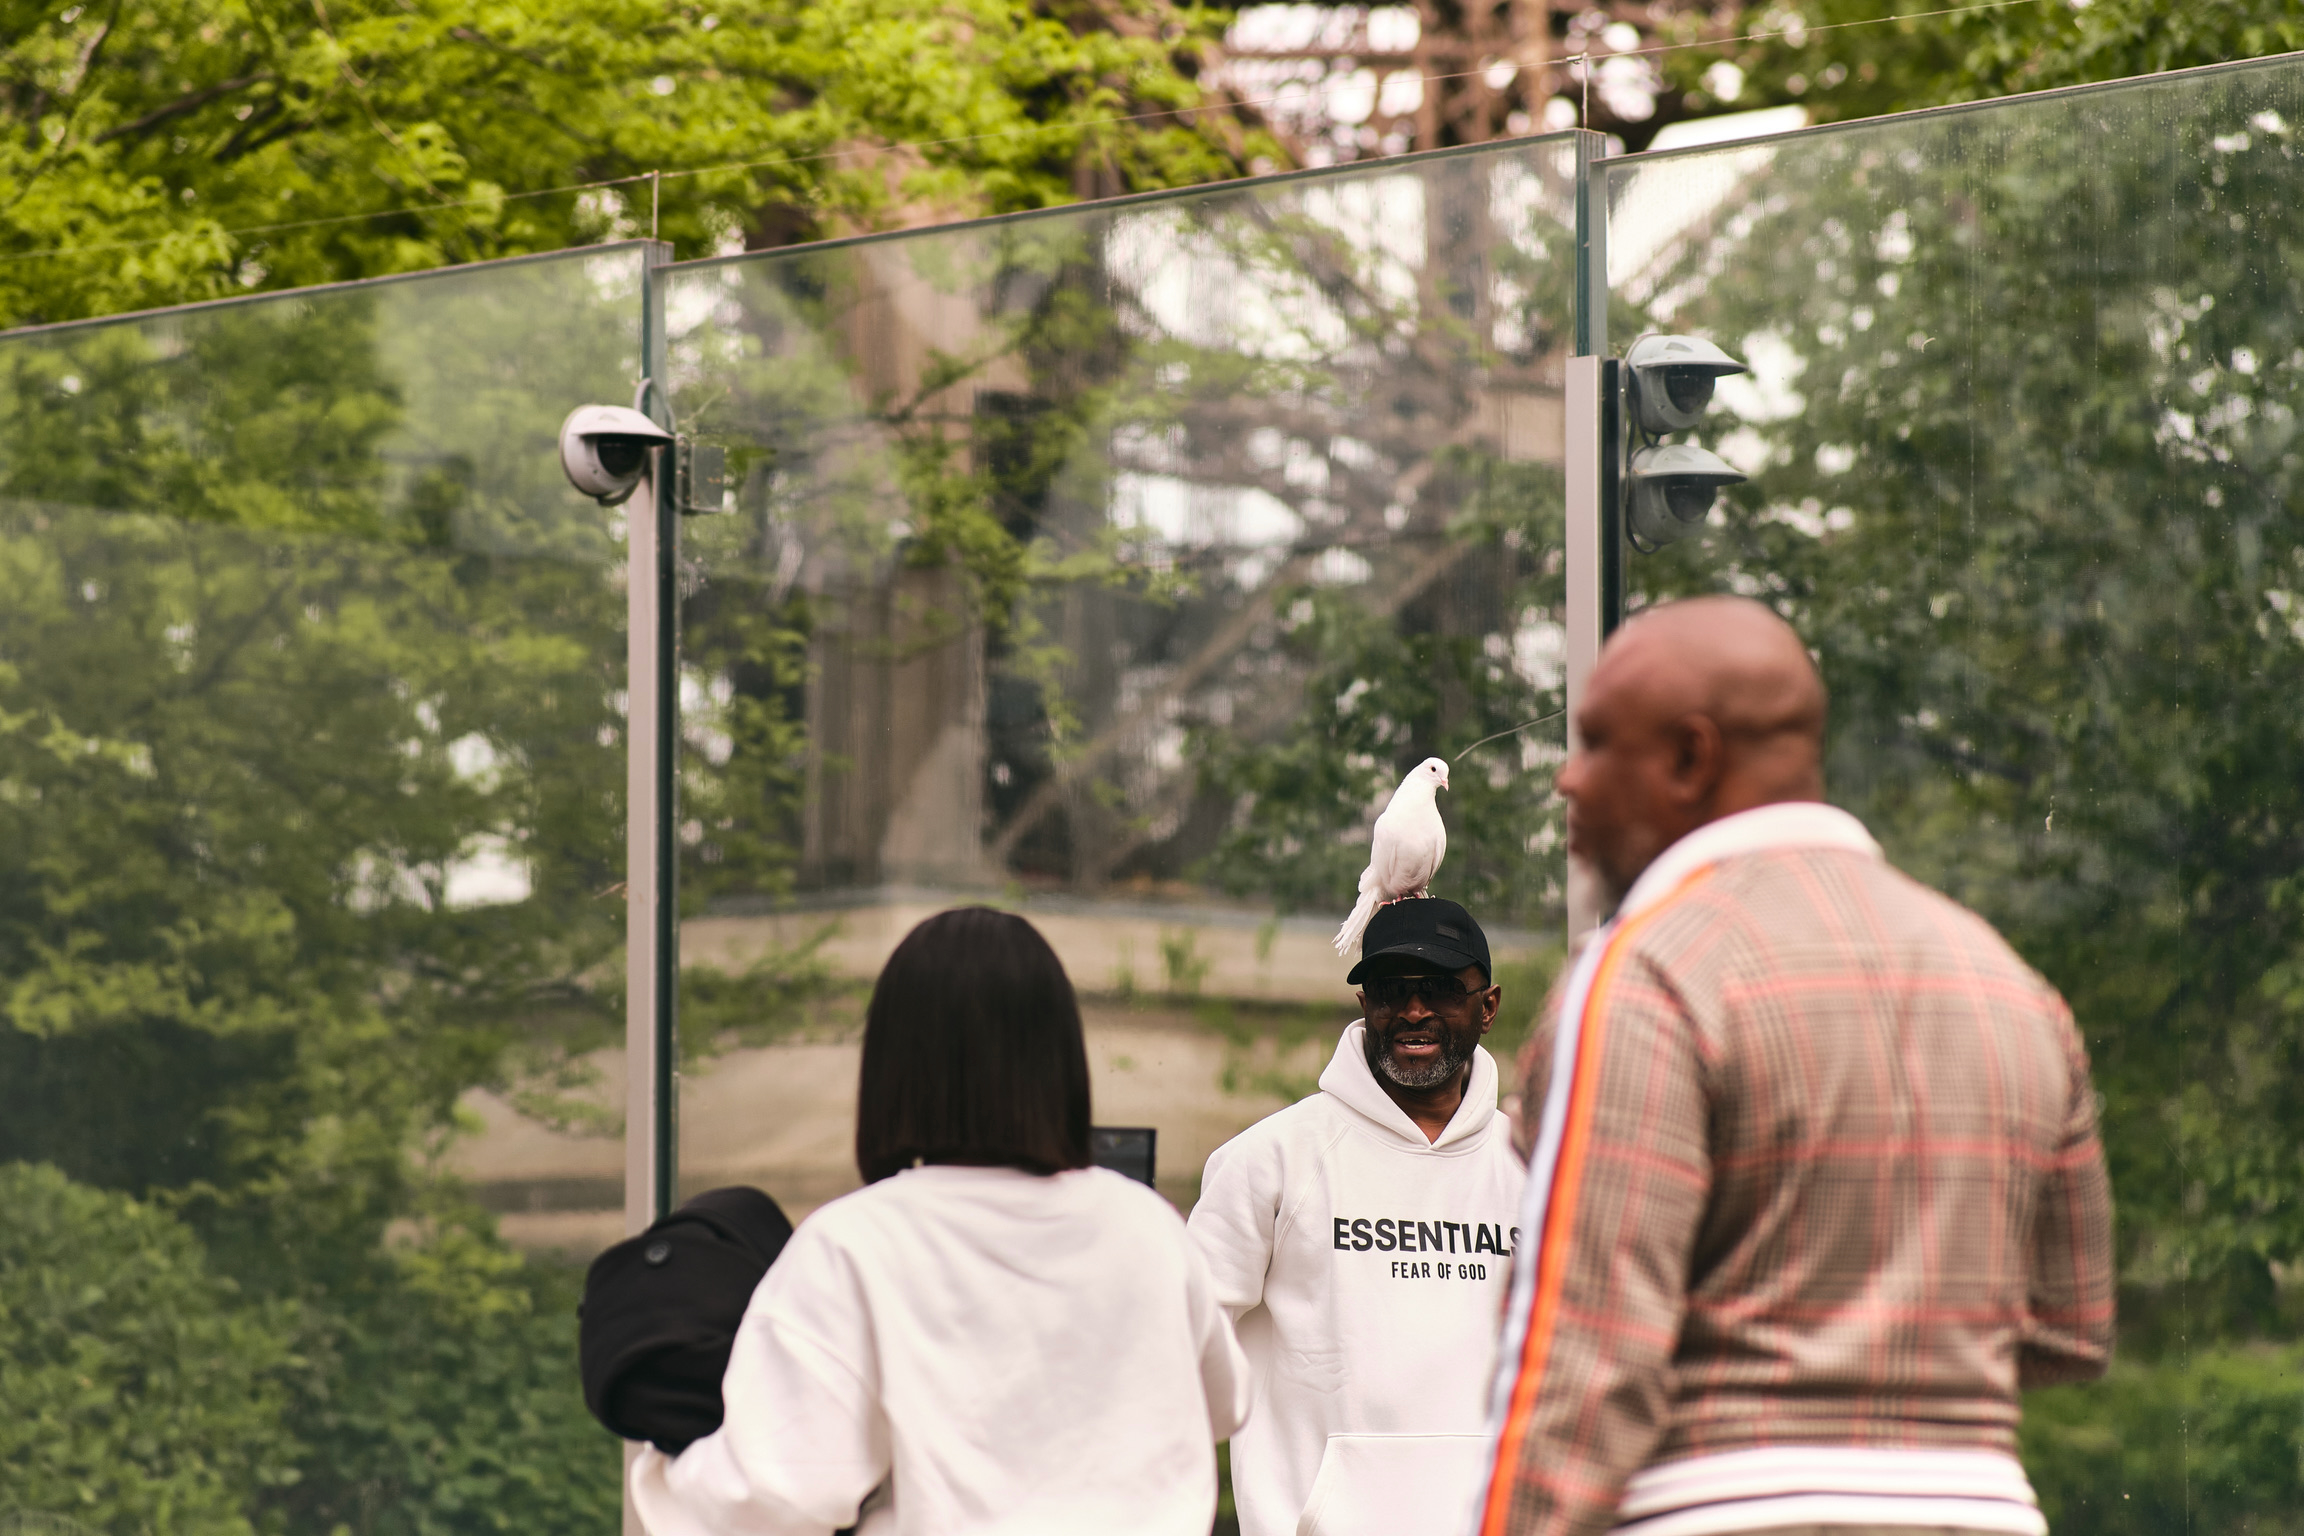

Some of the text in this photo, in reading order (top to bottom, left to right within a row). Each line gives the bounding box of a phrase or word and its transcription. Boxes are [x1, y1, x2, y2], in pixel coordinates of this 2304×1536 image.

[1392, 1261, 1487, 1281] FEAR OF GOD
